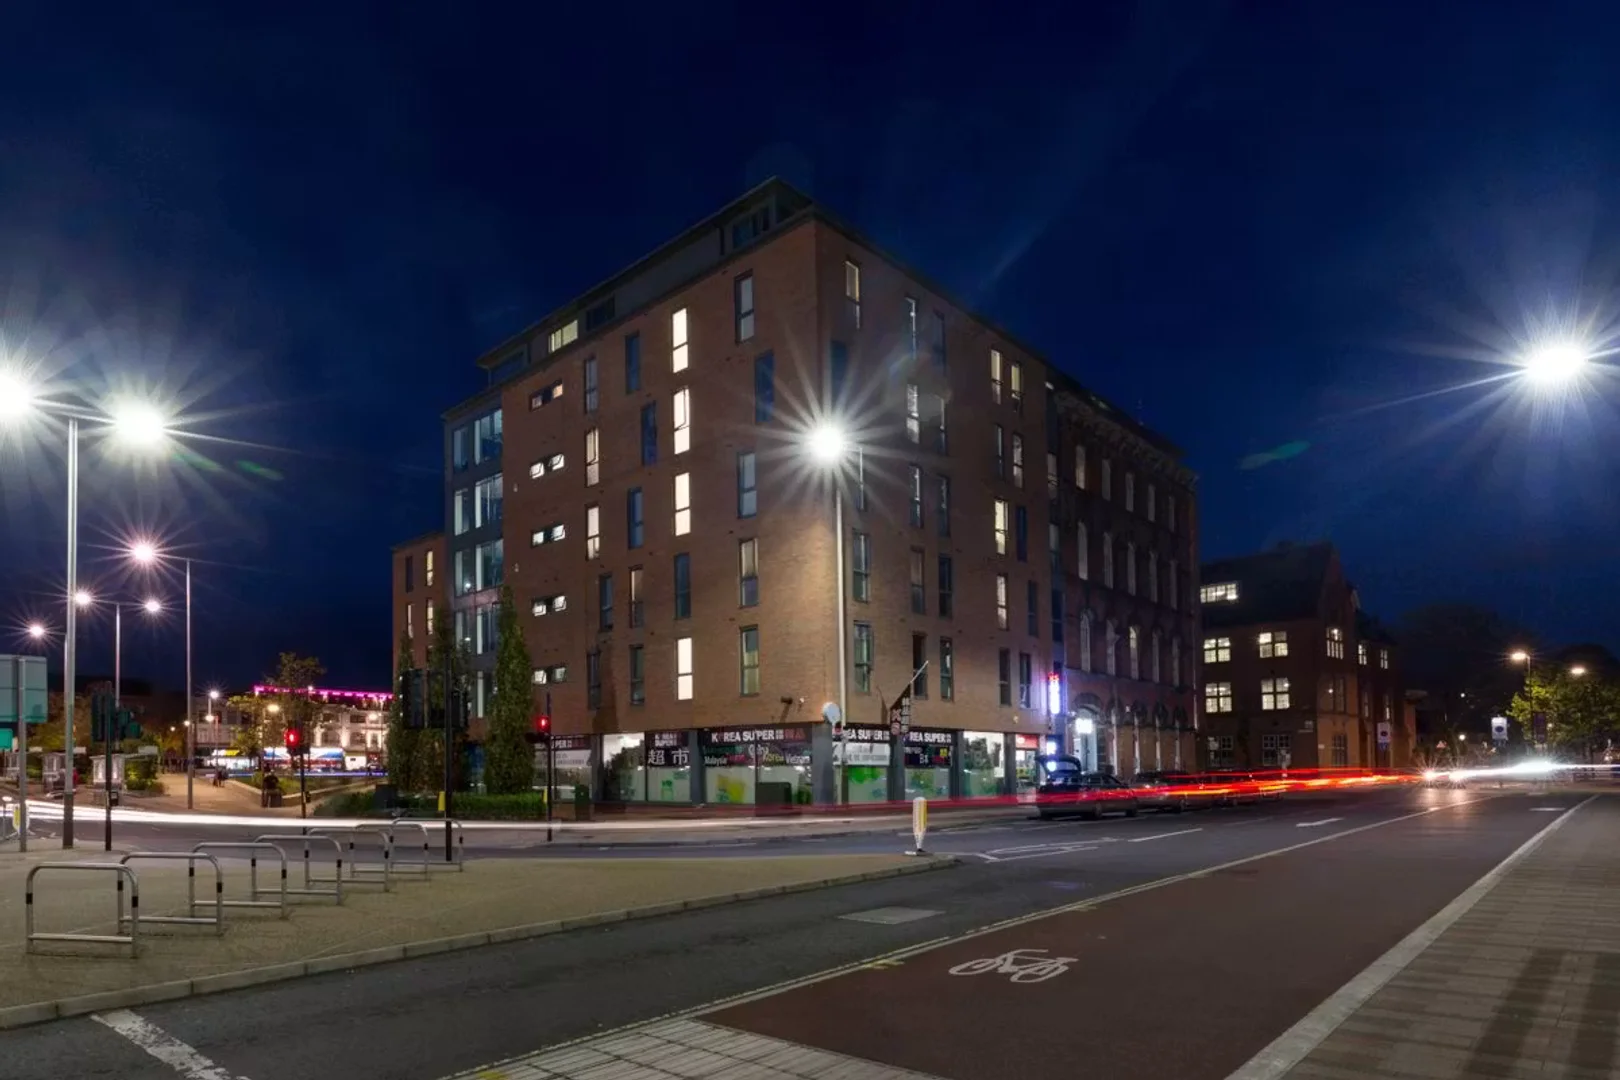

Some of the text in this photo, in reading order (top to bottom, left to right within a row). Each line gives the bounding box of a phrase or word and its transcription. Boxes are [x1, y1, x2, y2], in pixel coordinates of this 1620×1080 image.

[742, 730, 775, 742] SUPER
[858, 729, 883, 741] SUPER
[923, 732, 946, 744] SUPER
[647, 748, 690, 766] 超市
